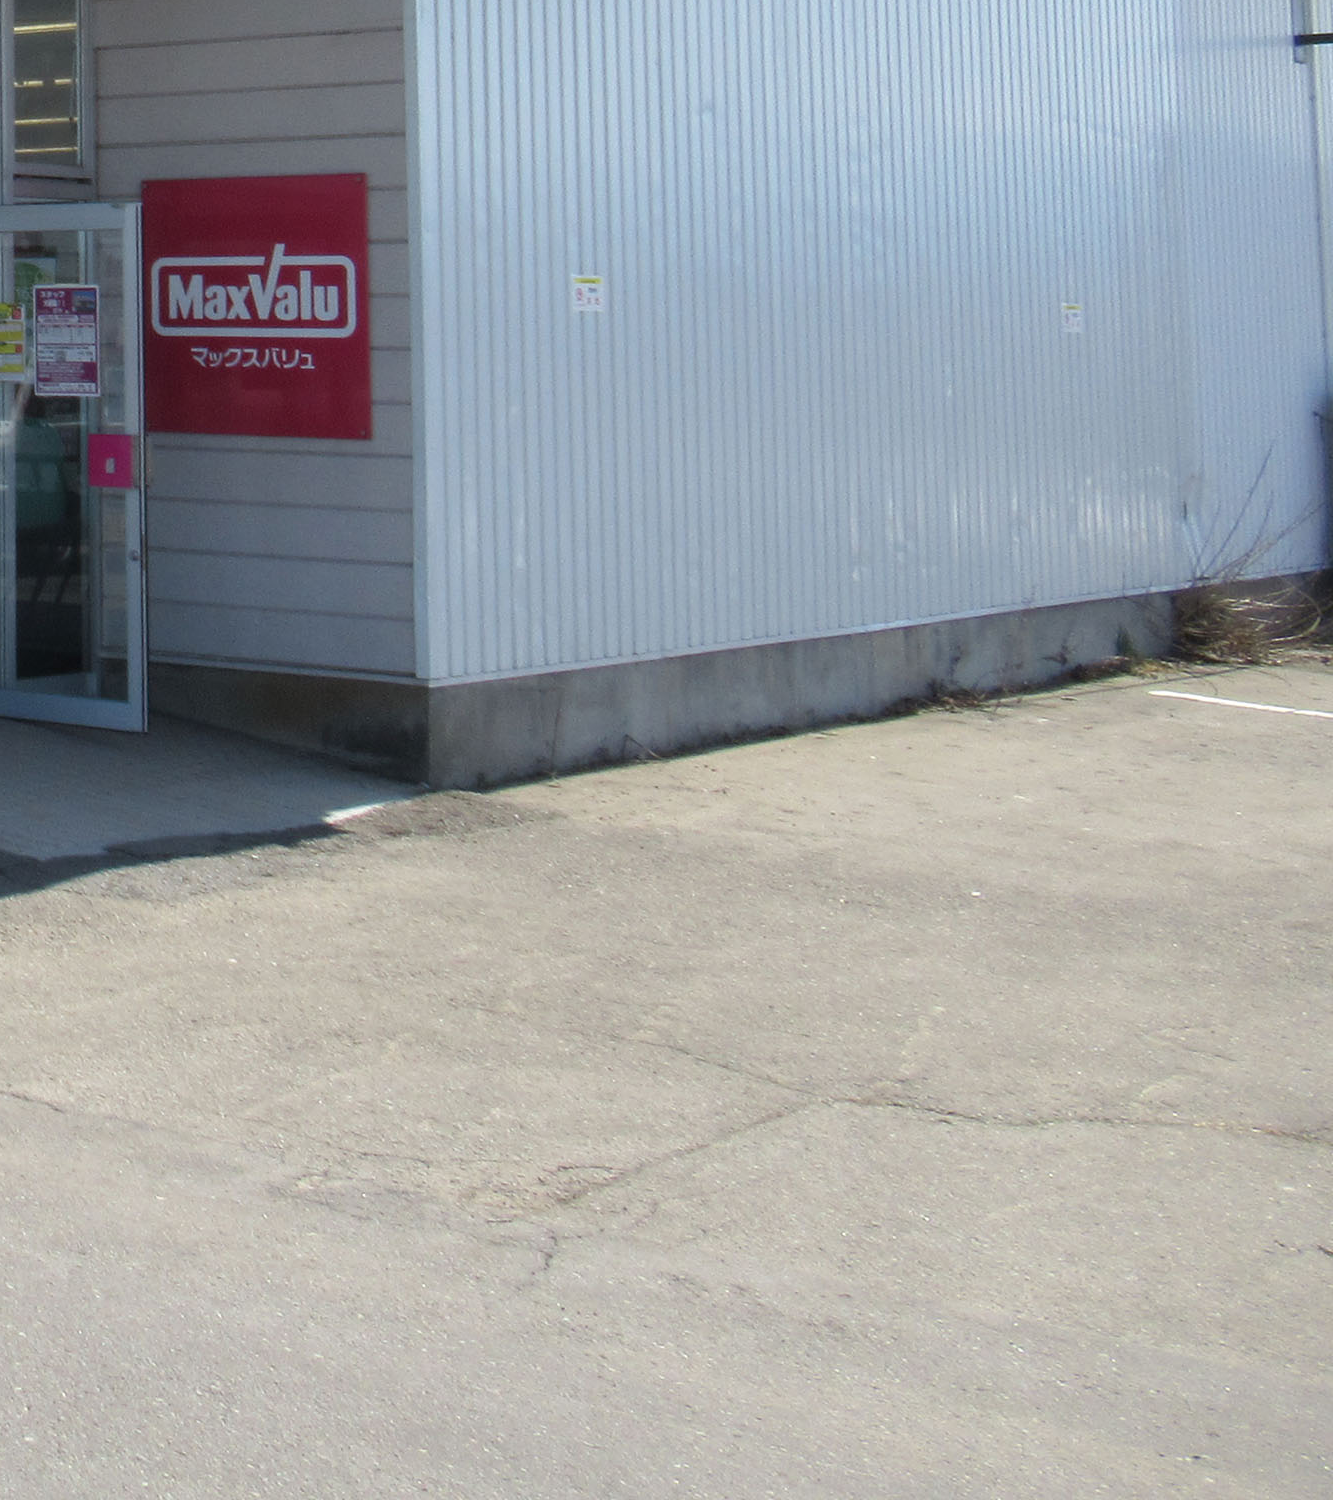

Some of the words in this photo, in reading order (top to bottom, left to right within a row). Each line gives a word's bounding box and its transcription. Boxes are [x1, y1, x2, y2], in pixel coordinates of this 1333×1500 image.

[168, 243, 339, 321] MaxValu
[190, 347, 316, 369] マックスバリュ
